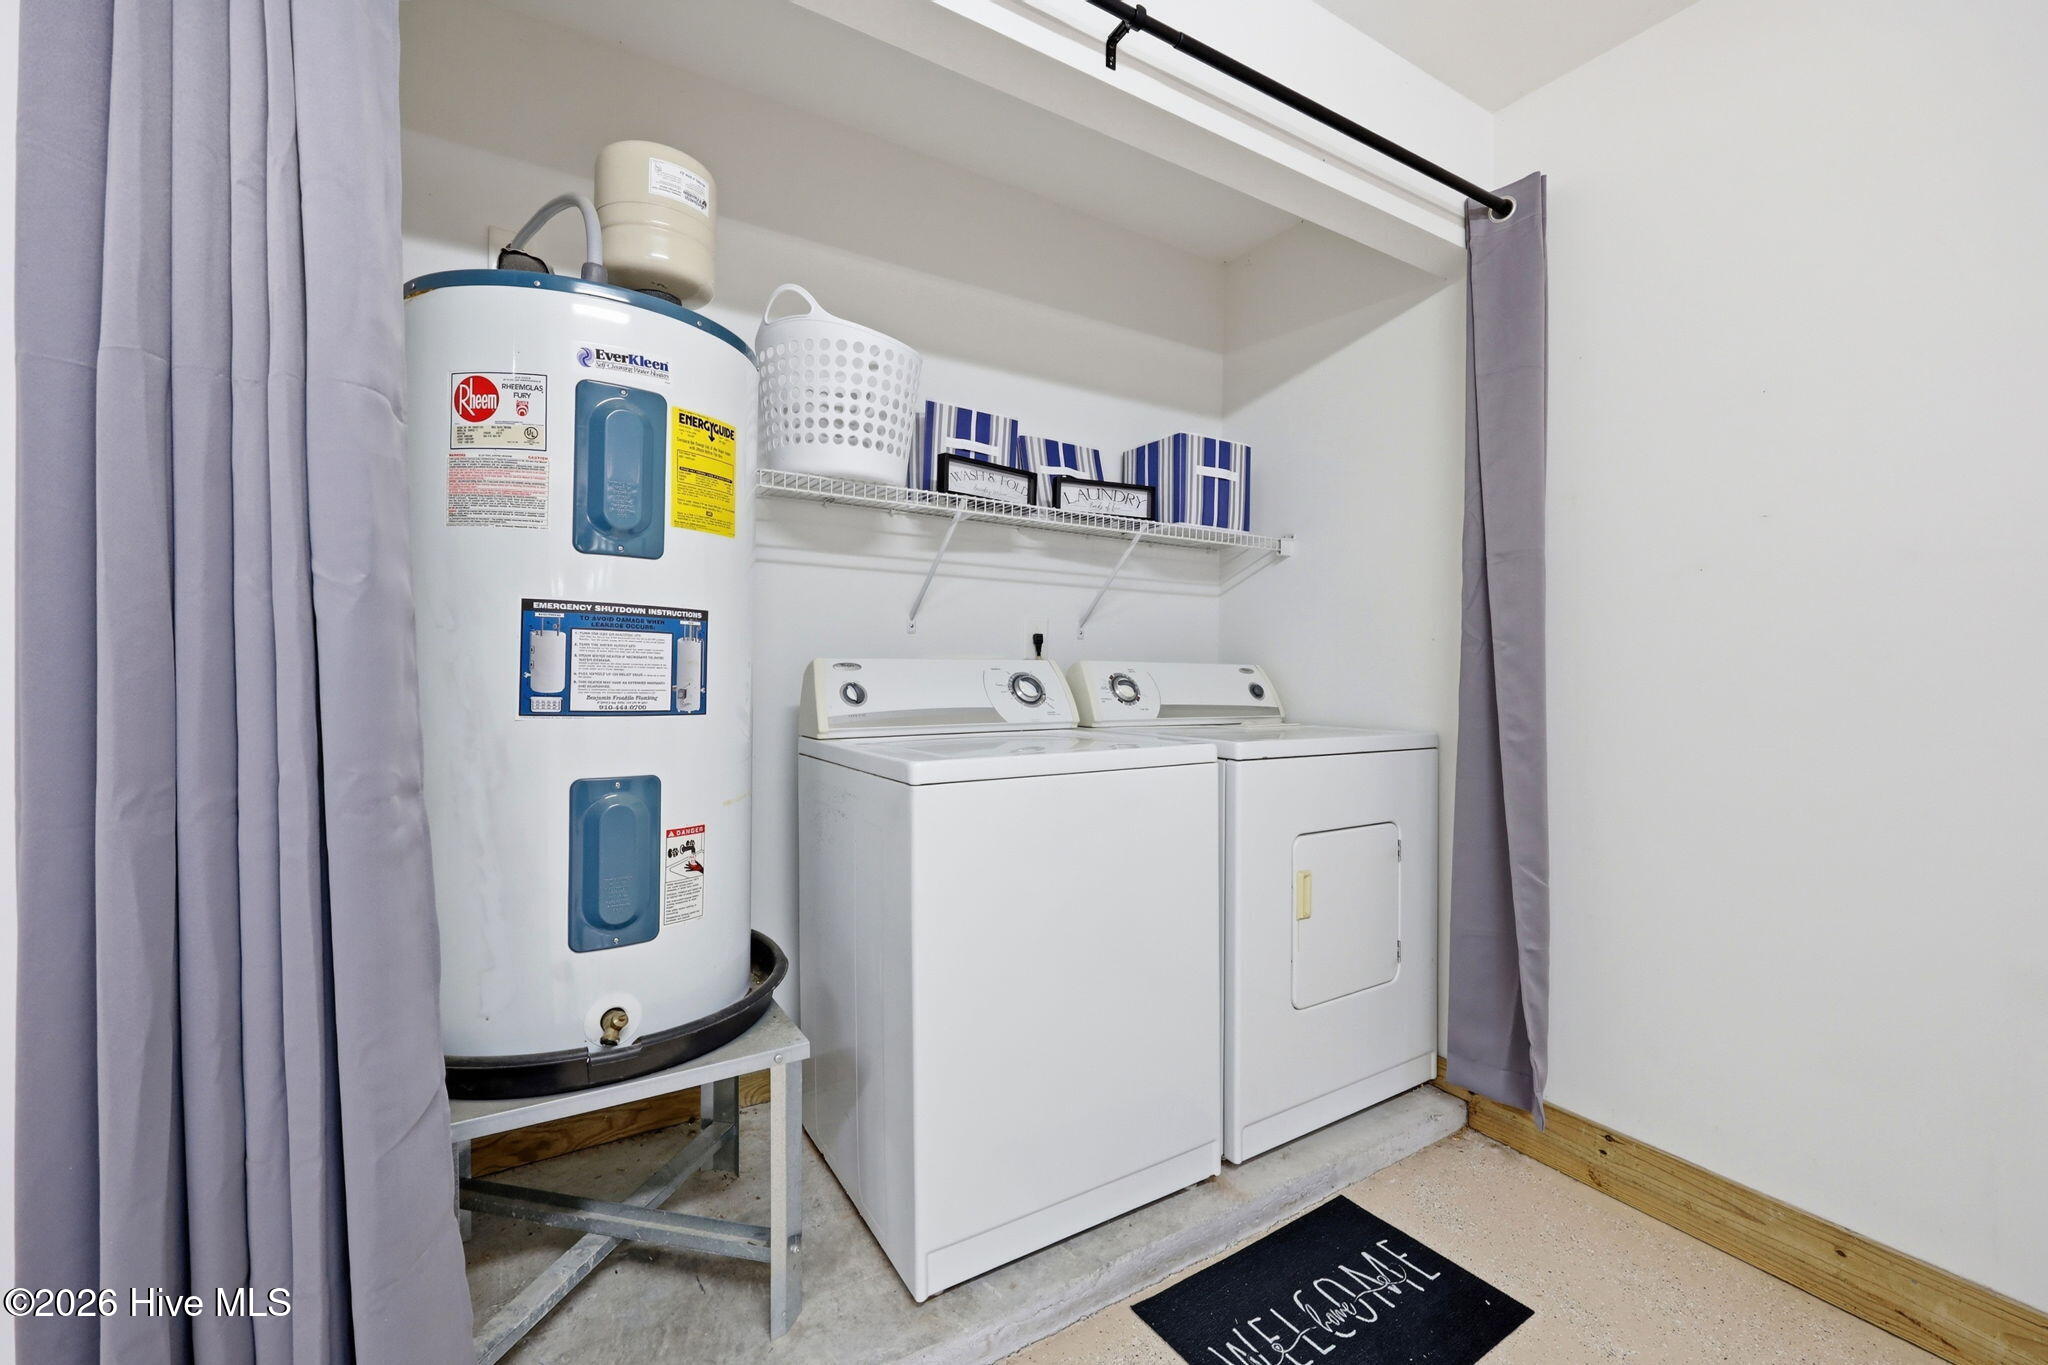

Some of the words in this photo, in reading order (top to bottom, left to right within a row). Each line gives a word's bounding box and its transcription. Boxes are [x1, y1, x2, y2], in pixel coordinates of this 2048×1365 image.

[595, 348, 669, 372] EverKleen
[459, 377, 497, 416] Rheem
[501, 383, 544, 392] RHEEMGLAS
[679, 413, 735, 441] ENERGYGUIDE
[950, 470, 985, 482] WASH
[987, 472, 995, 482] &
[1064, 488, 1147, 508] LAUNDRY
[532, 602, 593, 611] EMERGENCY
[594, 605, 646, 615] SHUTDOWN
[648, 608, 702, 619] INSTRUCTIONS
[676, 827, 704, 836] DANGER
[1208, 1240, 1440, 1365] WELCOME
